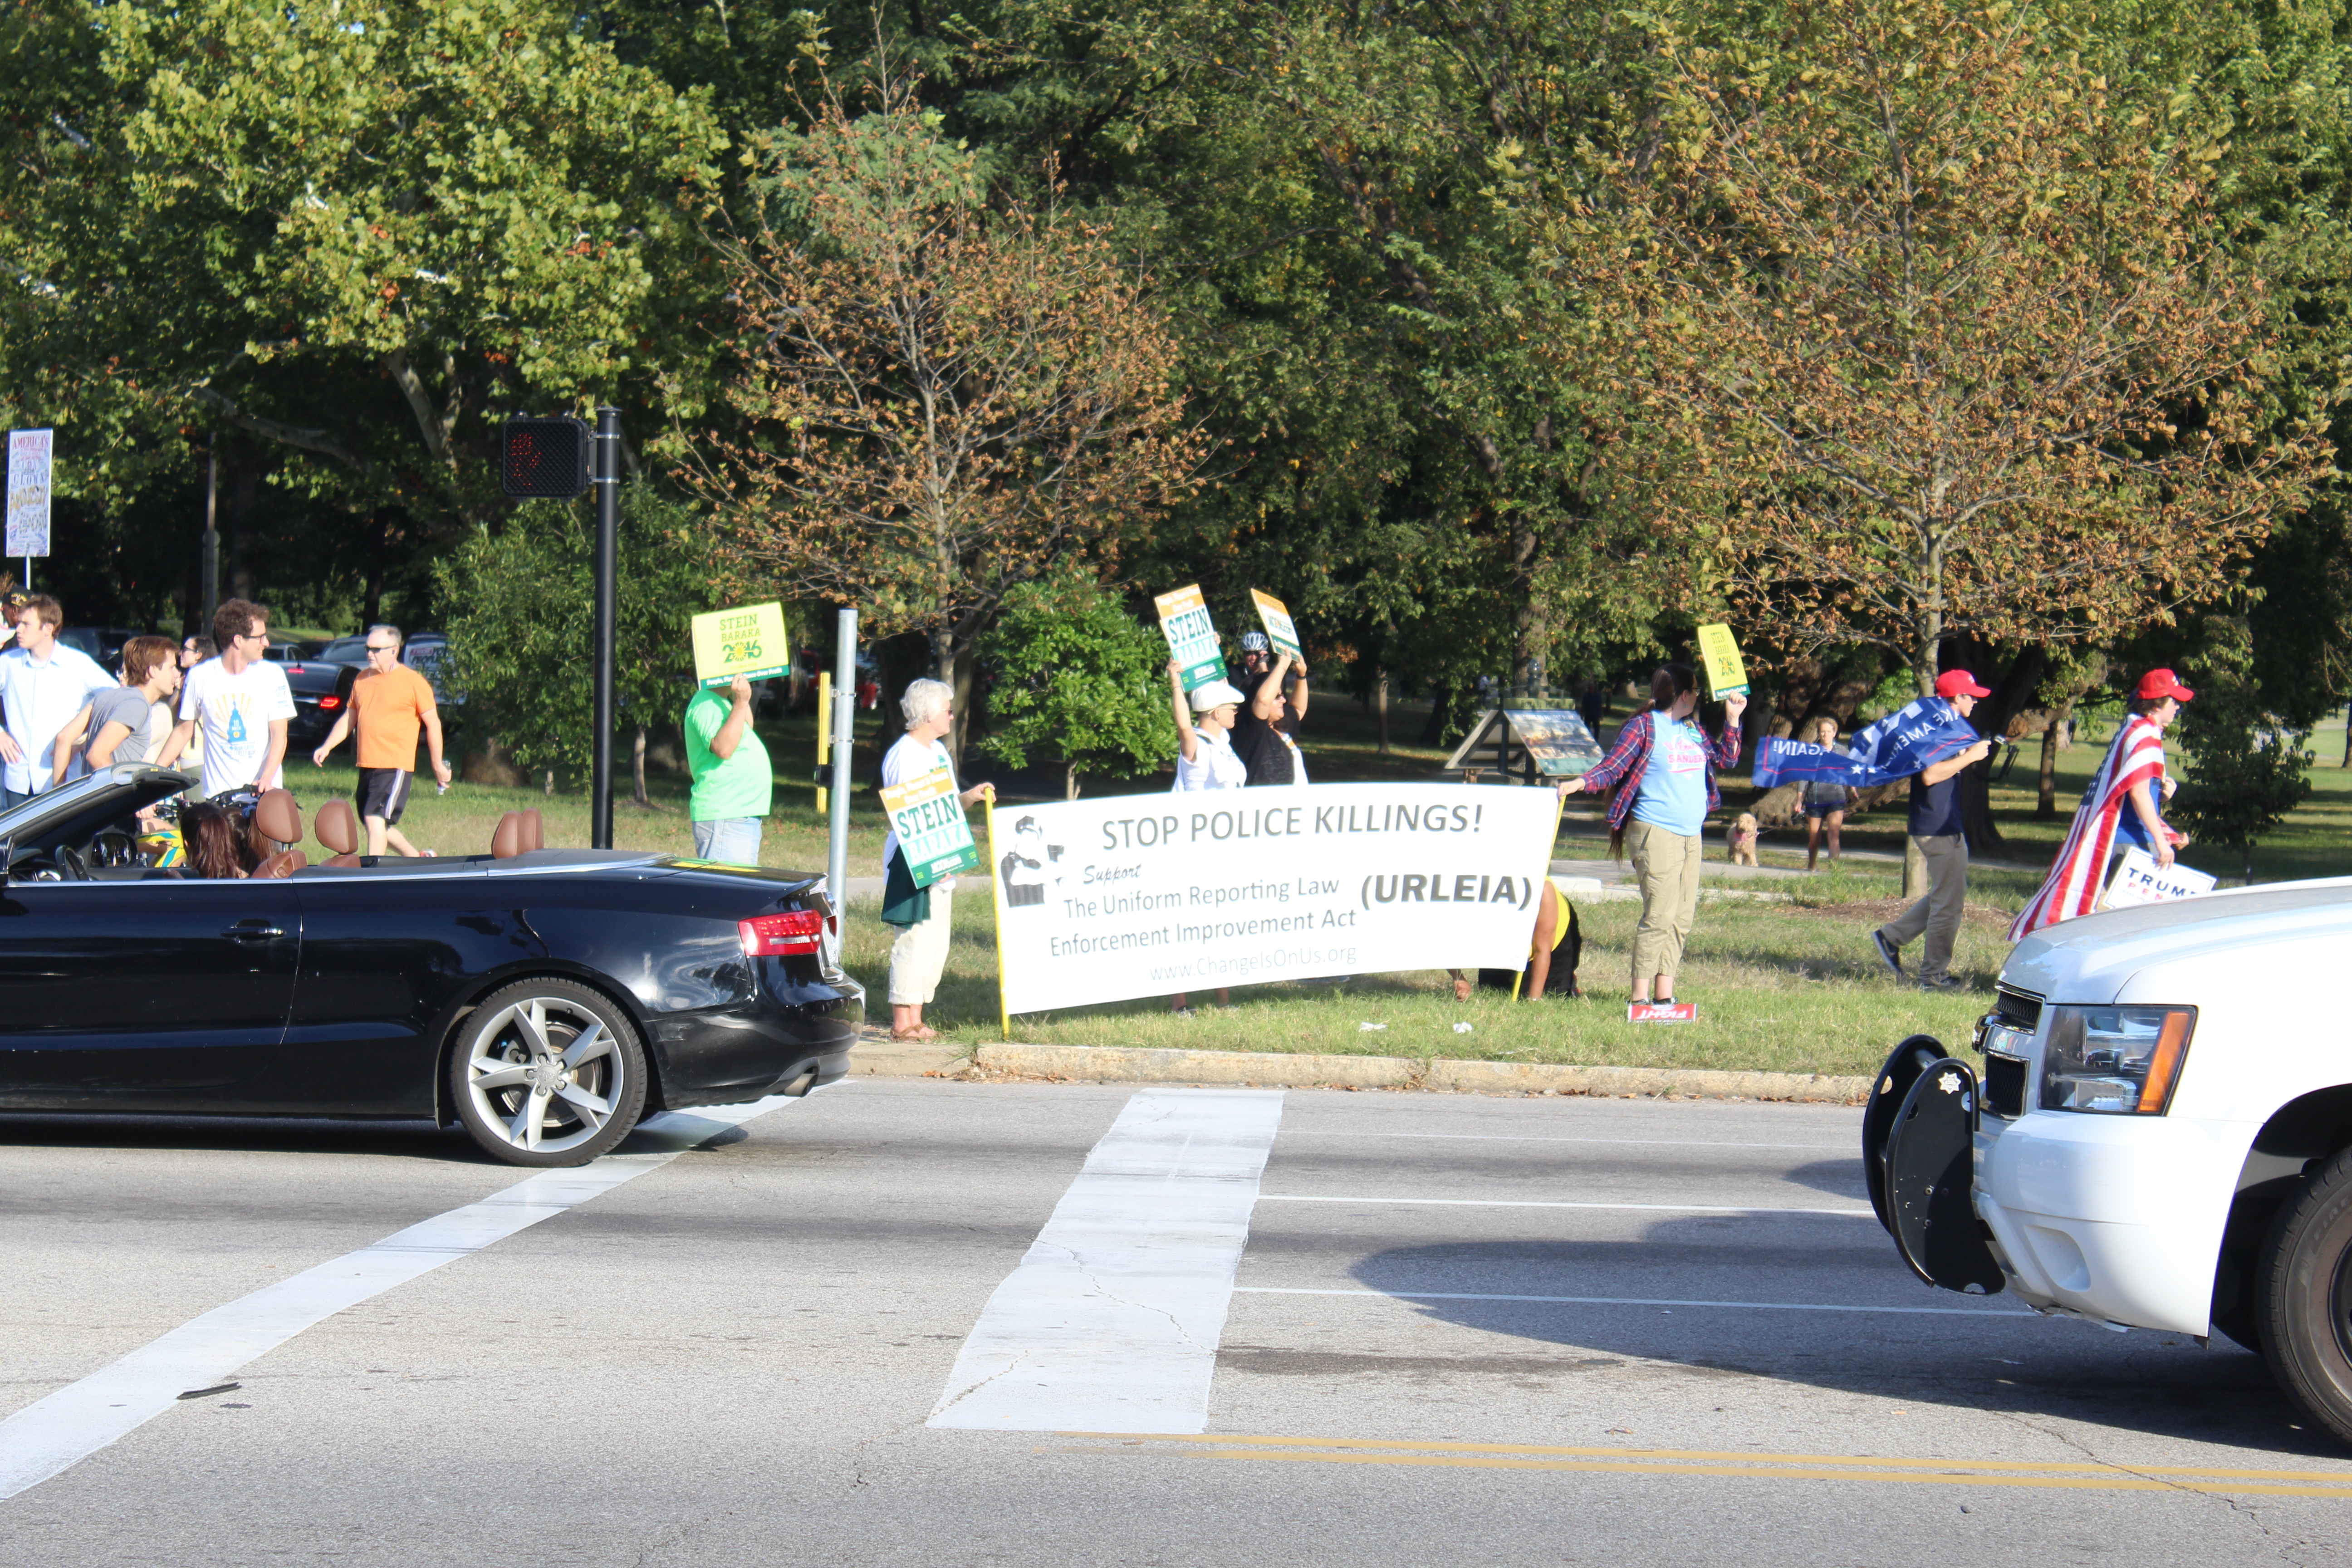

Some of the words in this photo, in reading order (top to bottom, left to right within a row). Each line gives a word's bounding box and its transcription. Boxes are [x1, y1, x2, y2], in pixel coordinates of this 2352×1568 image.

[13, 435, 49, 450] AMERICA'S
[720, 614, 758, 631] STEIN
[721, 628, 760, 642] BARAKA
[1168, 608, 1210, 645] STEIN
[1710, 631, 1726, 644] STEIN
[1176, 636, 1220, 669] BARAKA
[1668, 754, 1706, 763] SANDERS
[897, 794, 959, 839] STEIN
[1102, 816, 1179, 850] STOP
[1191, 807, 1302, 842] POLICE
[1315, 804, 1483, 834] KILLINGS!
[906, 823, 972, 866] BARAKA
[1083, 863, 1142, 886] Support
[1063, 897, 1097, 919] The
[1103, 890, 1181, 914] Uniform
[1189, 879, 1290, 908] Reporting
[1298, 877, 1340, 895] Law
[1361, 874, 1532, 911] (URLEIA)
[1050, 926, 1169, 957] Enforcement
[1176, 912, 1314, 944] Improvement
[1321, 909, 1356, 928] Act
[1149, 947, 1357, 981] www.ChangeIsOnUs.org
